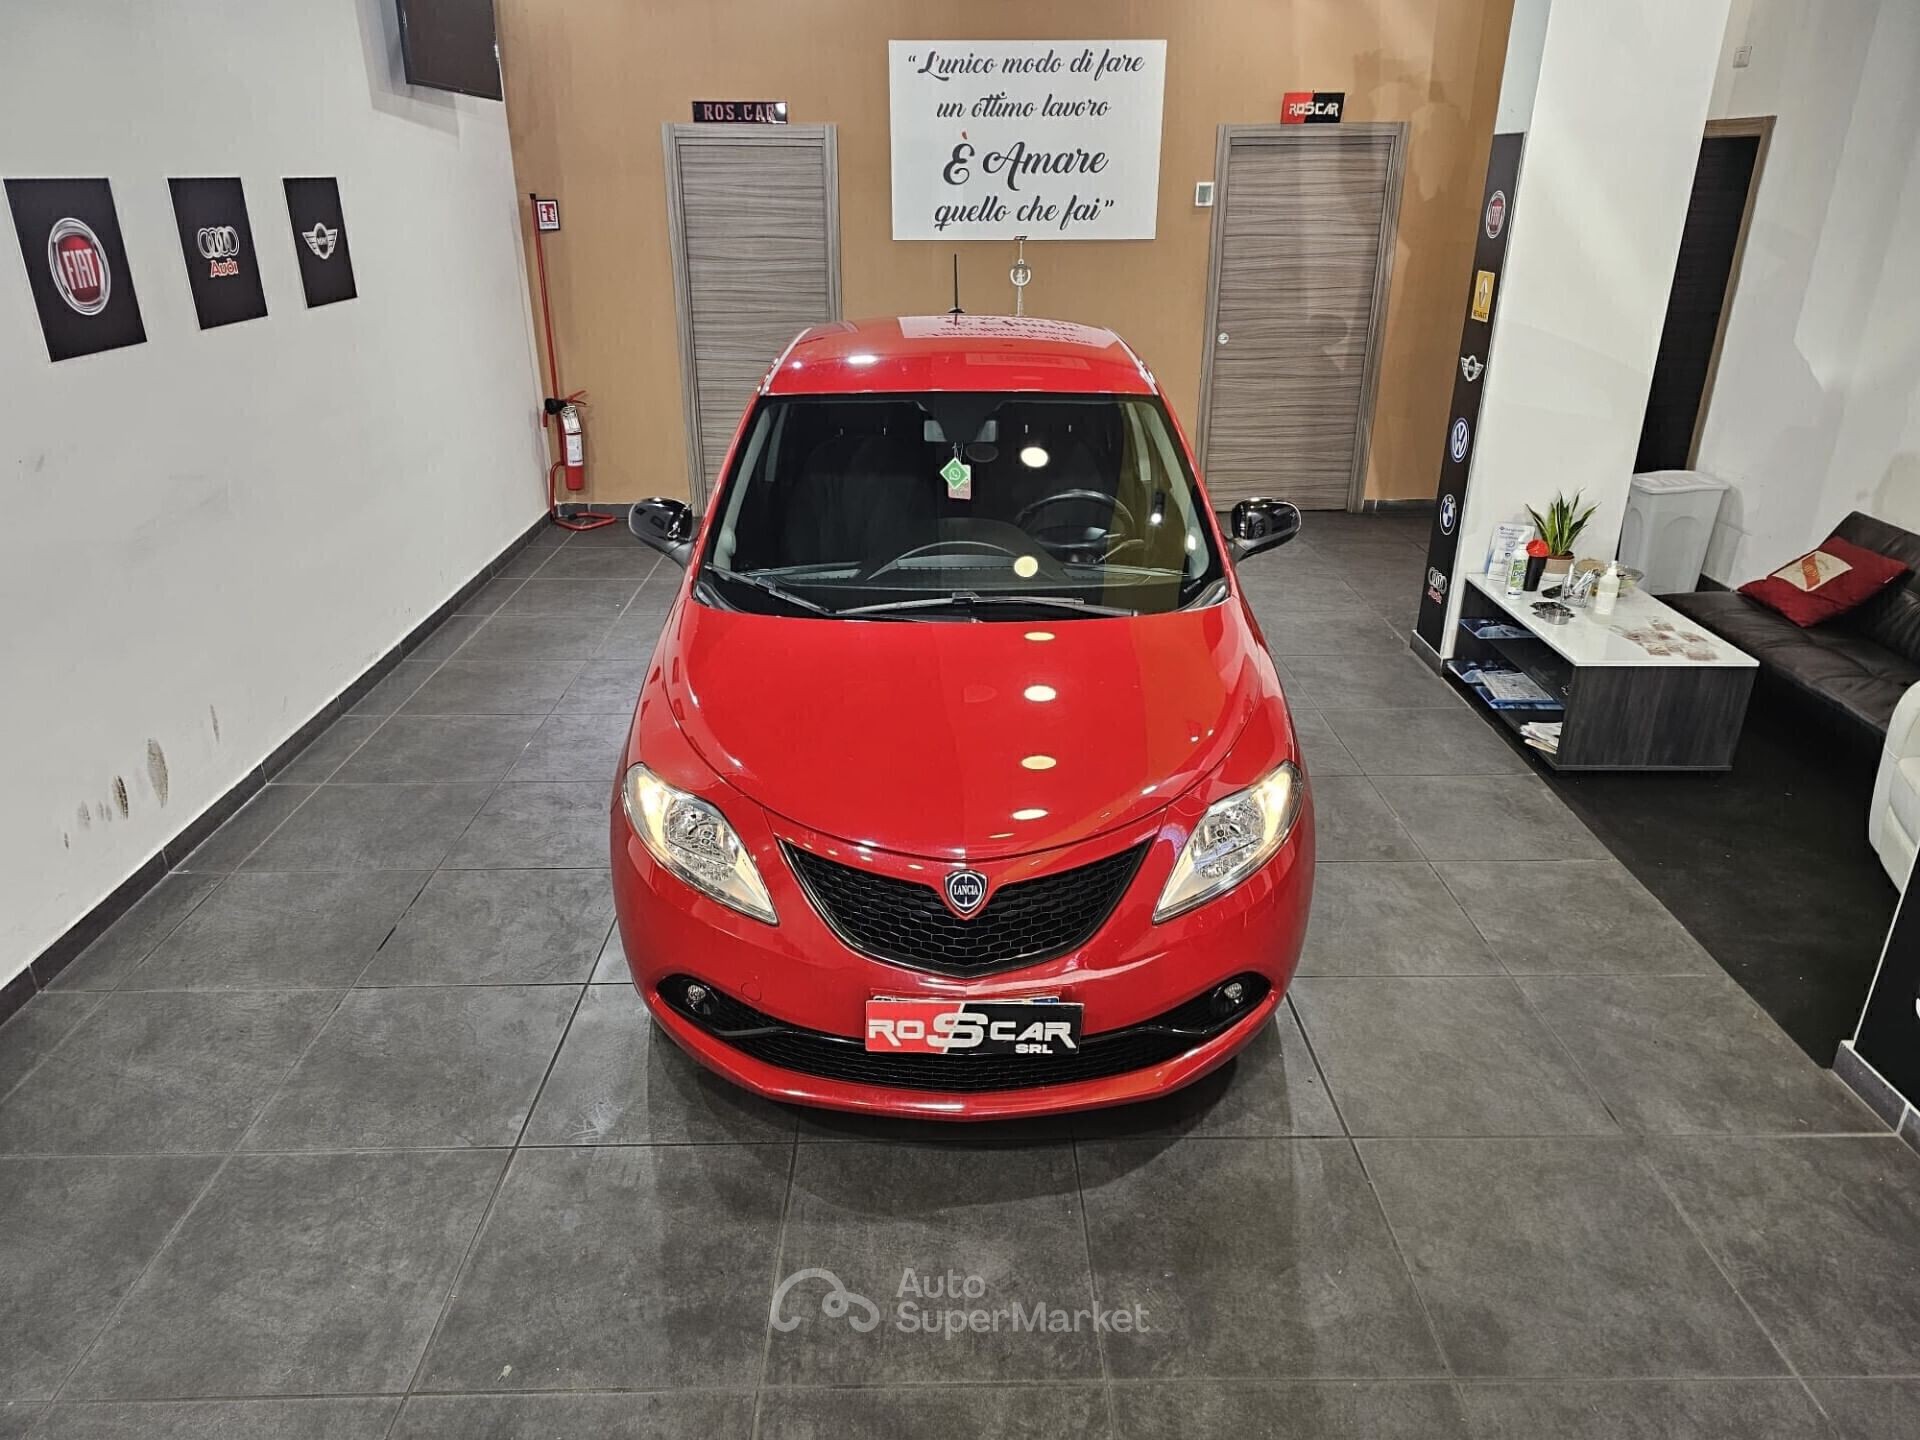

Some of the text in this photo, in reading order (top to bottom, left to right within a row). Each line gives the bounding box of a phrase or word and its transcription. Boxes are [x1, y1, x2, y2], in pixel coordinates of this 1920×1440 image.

[1002, 48, 1064, 74] modo
[1069, 48, 1094, 74] di
[1094, 48, 1145, 81] fare
[936, 91, 1112, 118] un ottimo lavoro
[1288, 101, 1339, 117] ROSCAR
[943, 130, 1109, 191] È Amare
[934, 195, 1010, 231] quello
[1016, 195, 1060, 222] che
[62, 248, 98, 290] FIAT
[210, 258, 239, 278] Audi
[953, 884, 979, 895] LANCIA
[1014, 1044, 1053, 1054] SRL
